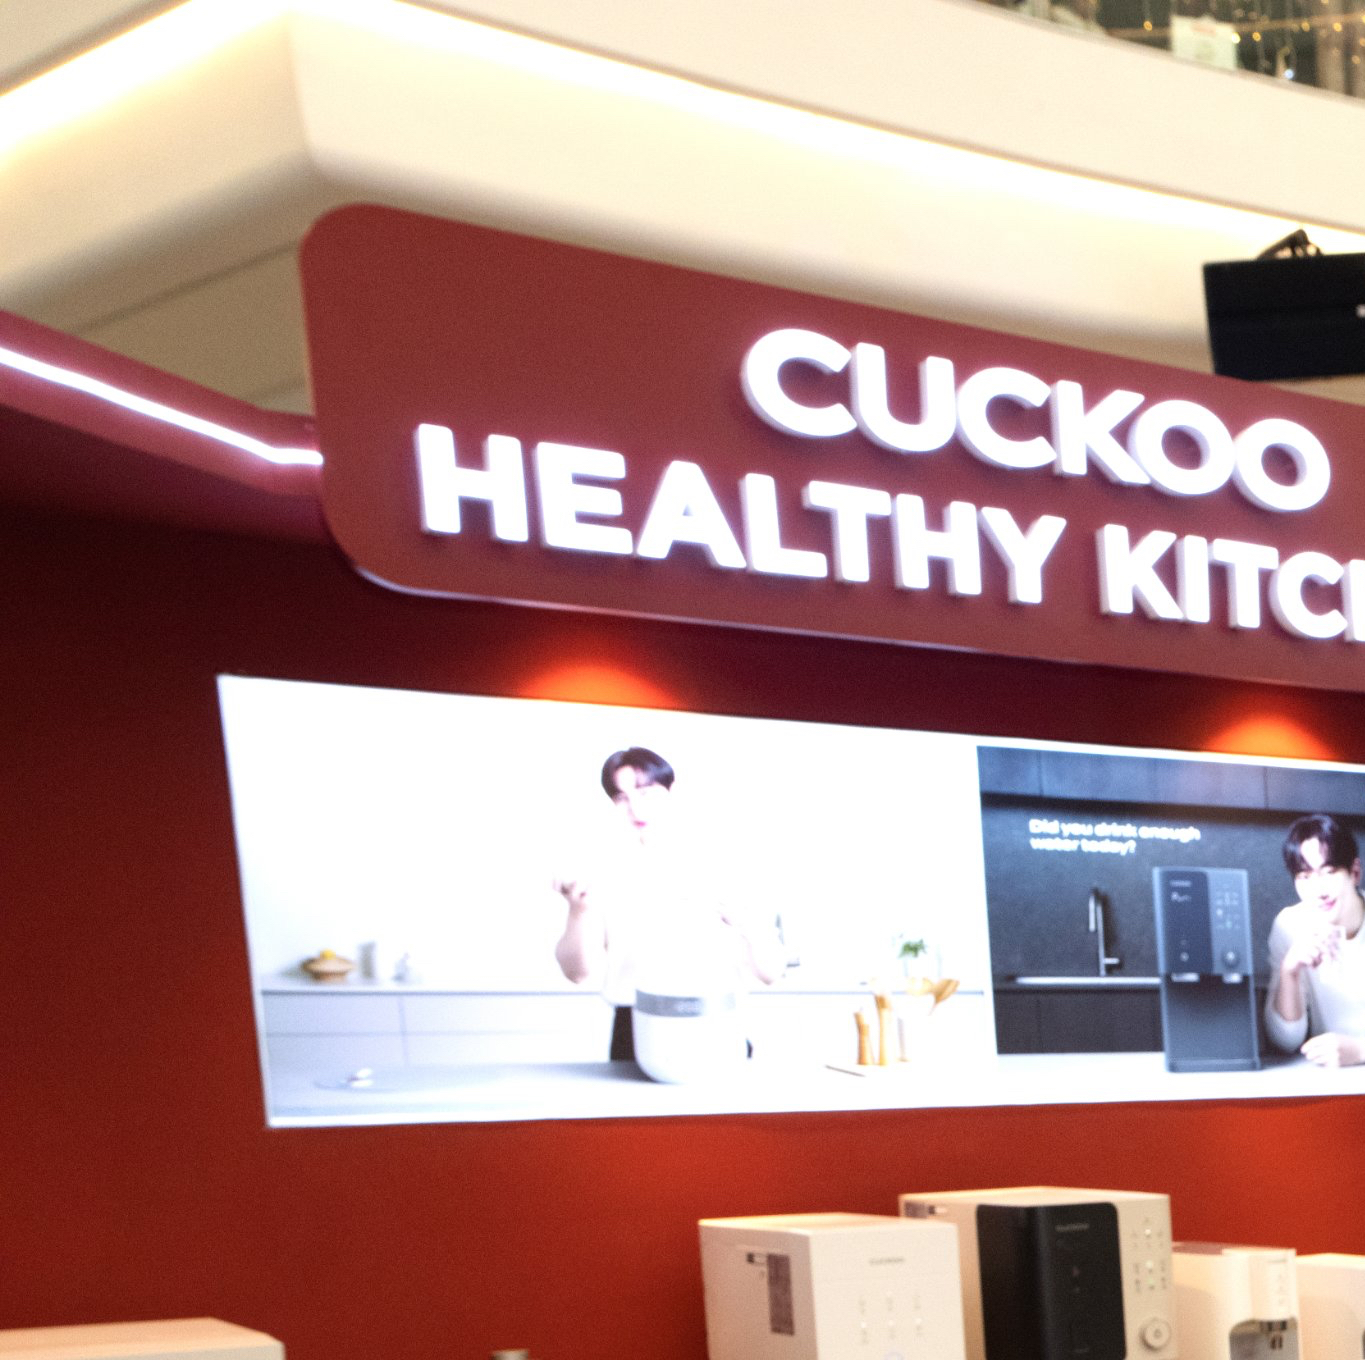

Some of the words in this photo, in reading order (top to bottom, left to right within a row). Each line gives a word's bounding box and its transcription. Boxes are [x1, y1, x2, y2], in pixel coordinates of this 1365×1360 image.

[742, 328, 1332, 513] CUCKOO
[413, 422, 1067, 605] HEALTHY
[1029, 818, 1060, 834] Did
[1061, 822, 1094, 838] you
[1094, 822, 1138, 838] drink
[1138, 826, 1201, 843] enough
[1029, 837, 1080, 851] water
[1080, 838, 1137, 856] today?
